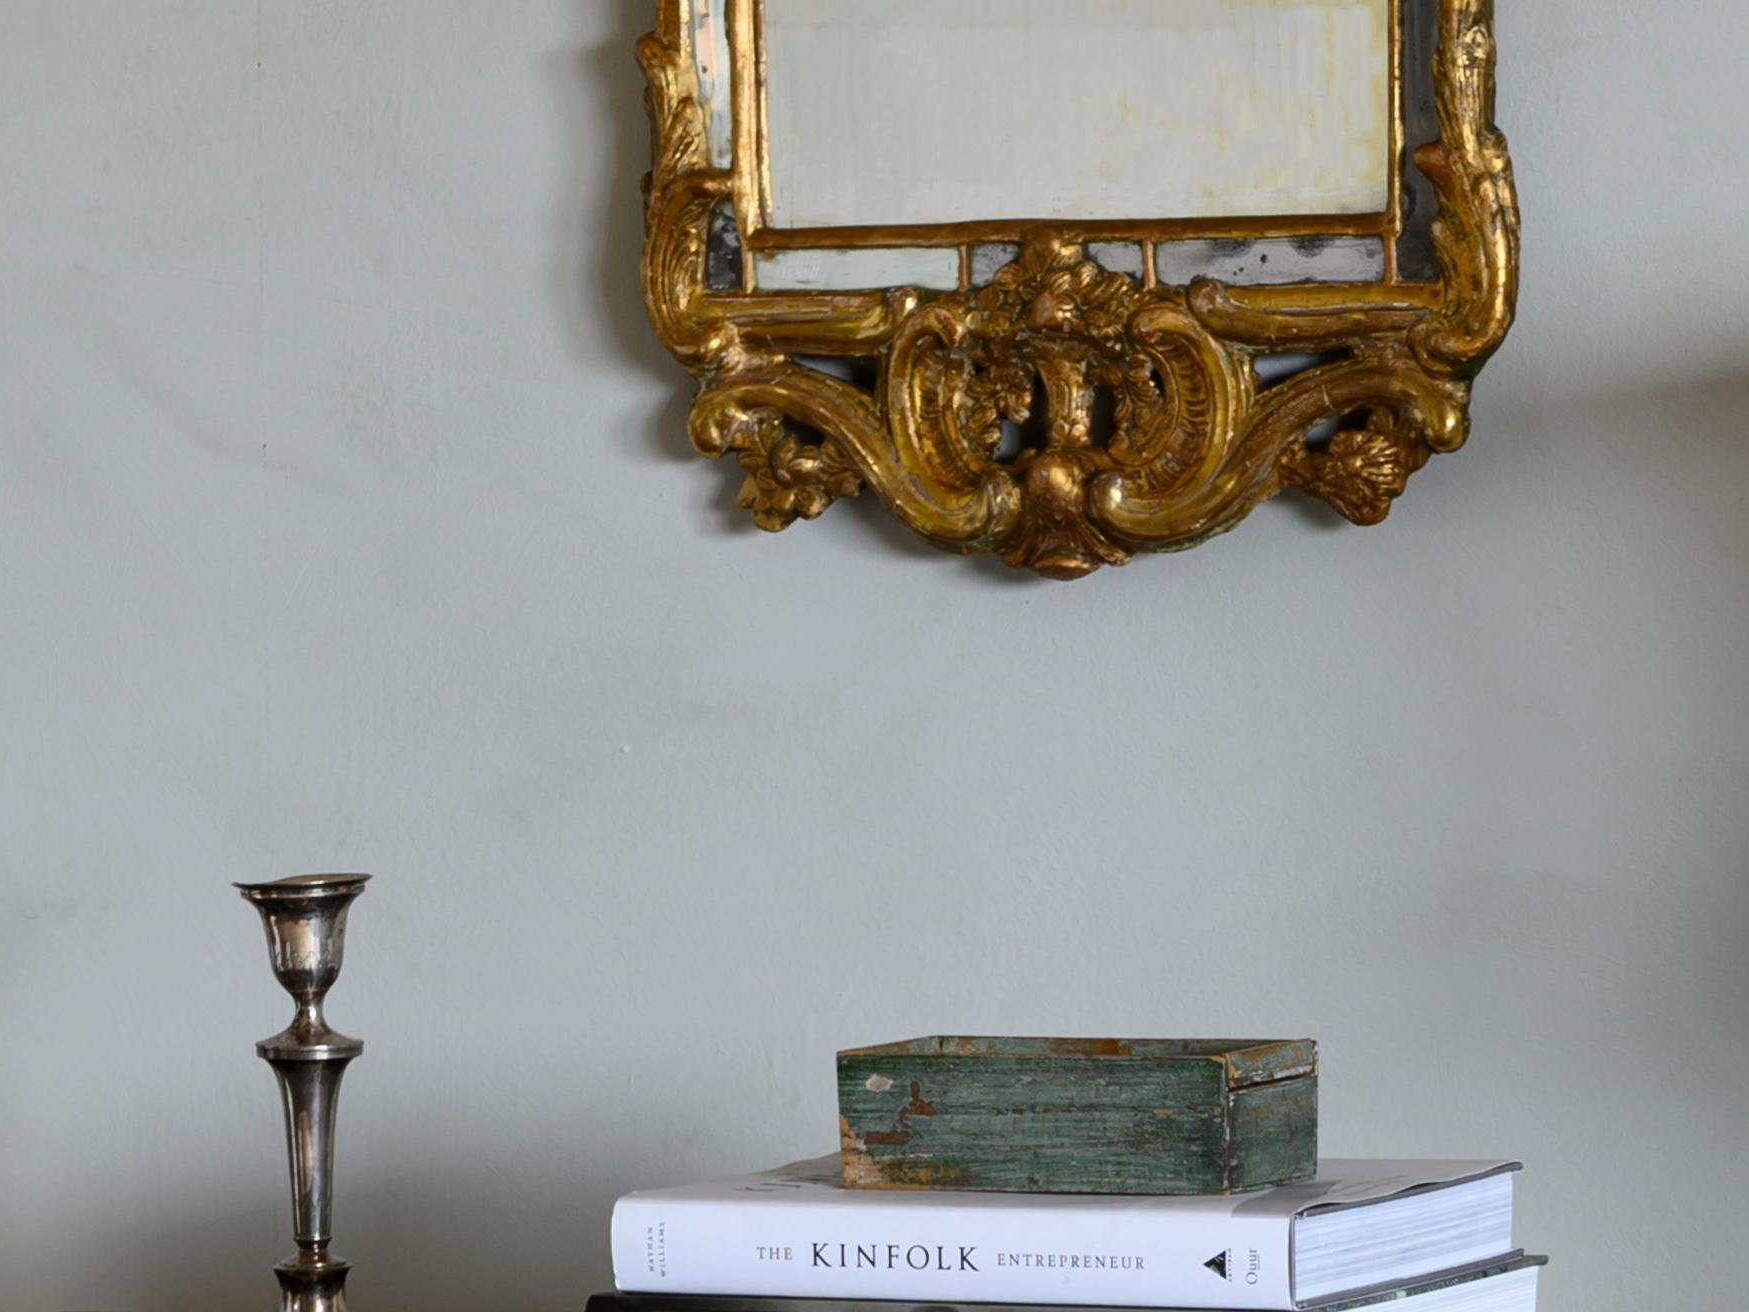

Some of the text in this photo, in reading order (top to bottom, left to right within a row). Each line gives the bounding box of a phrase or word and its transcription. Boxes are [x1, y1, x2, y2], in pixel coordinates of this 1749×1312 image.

[756, 1242, 1145, 1272] THE KINFOLK ENTREPRENEUR
